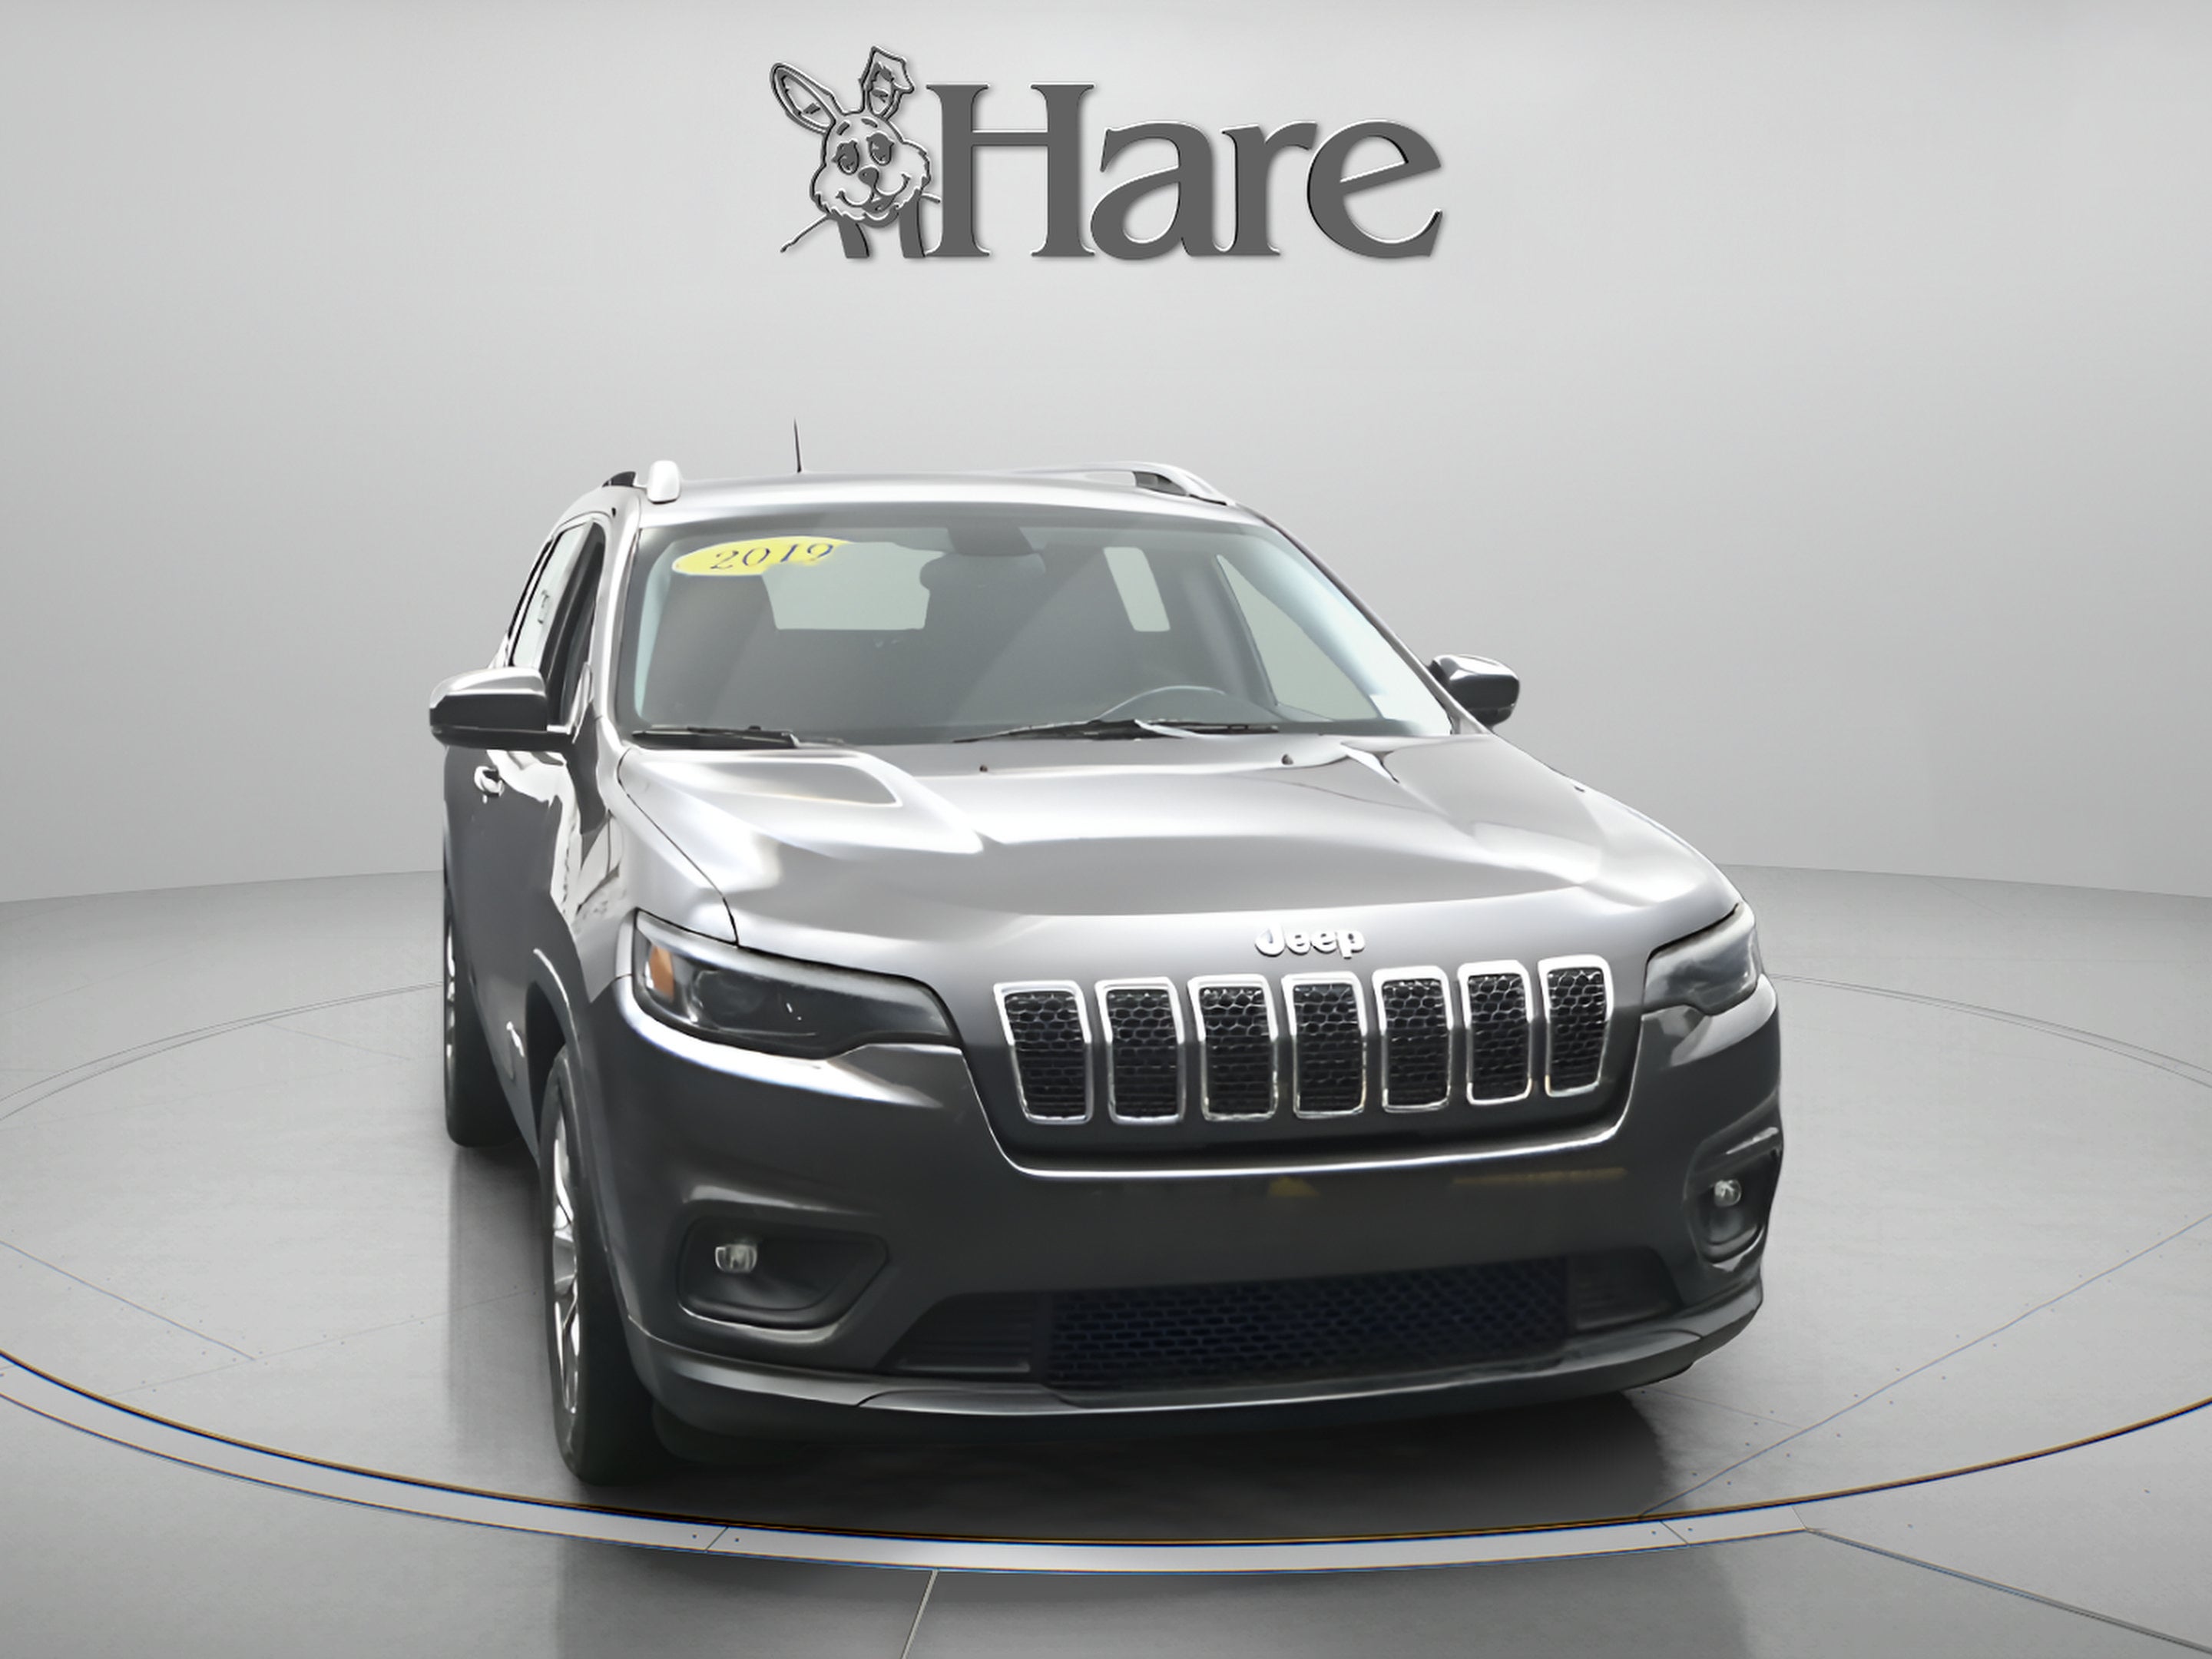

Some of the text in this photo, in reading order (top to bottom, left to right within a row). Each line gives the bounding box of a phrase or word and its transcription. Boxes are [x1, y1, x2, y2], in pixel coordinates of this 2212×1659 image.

[926, 82, 1442, 260] Hare
[710, 543, 834, 570] 2019
[1255, 921, 1366, 959] Jeep
